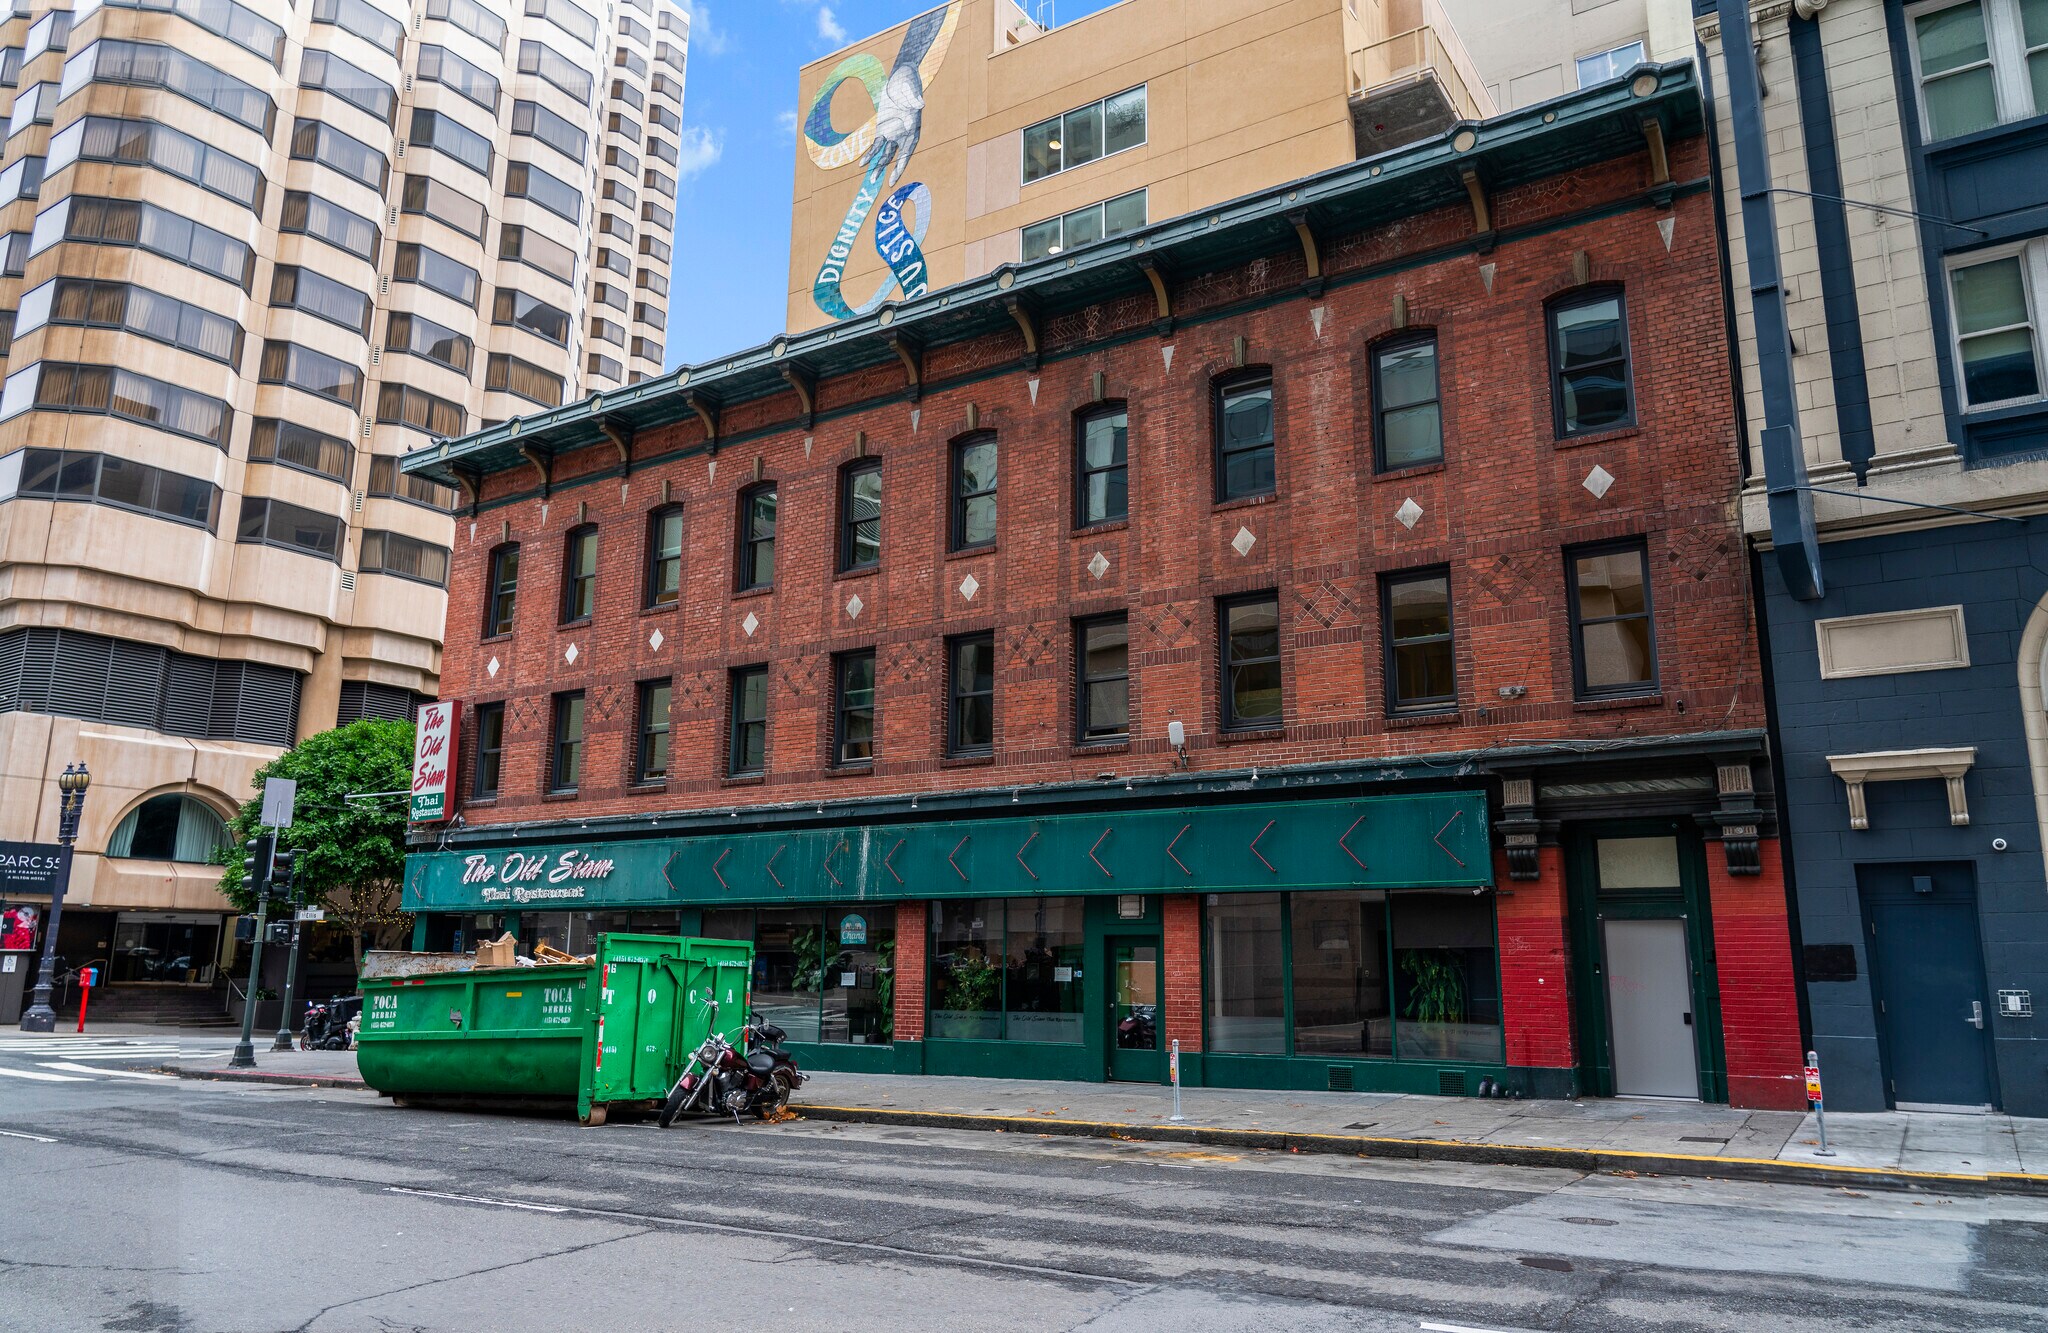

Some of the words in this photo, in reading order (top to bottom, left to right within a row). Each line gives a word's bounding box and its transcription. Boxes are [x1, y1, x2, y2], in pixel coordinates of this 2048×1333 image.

[817, 123, 871, 168] LOVE
[818, 187, 875, 284] DIGNITY
[878, 195, 928, 301] JUSTICE
[424, 706, 445, 732] The
[420, 735, 445, 759] Old
[413, 761, 446, 792] Siam
[418, 796, 439, 808] Thai
[411, 806, 444, 820] Restaurant
[0, 854, 42, 868] PARC
[462, 854, 496, 884] The
[499, 852, 548, 884] Old
[548, 849, 615, 883] Siam
[481, 887, 511, 902] Thai
[512, 886, 585, 903] Restaurant
[842, 930, 865, 942] Chang
[373, 995, 398, 1010] TOCA
[544, 987, 573, 1003] TOCA
[371, 1011, 397, 1020] DEBRIS
[542, 1005, 573, 1014] DEBRIS
